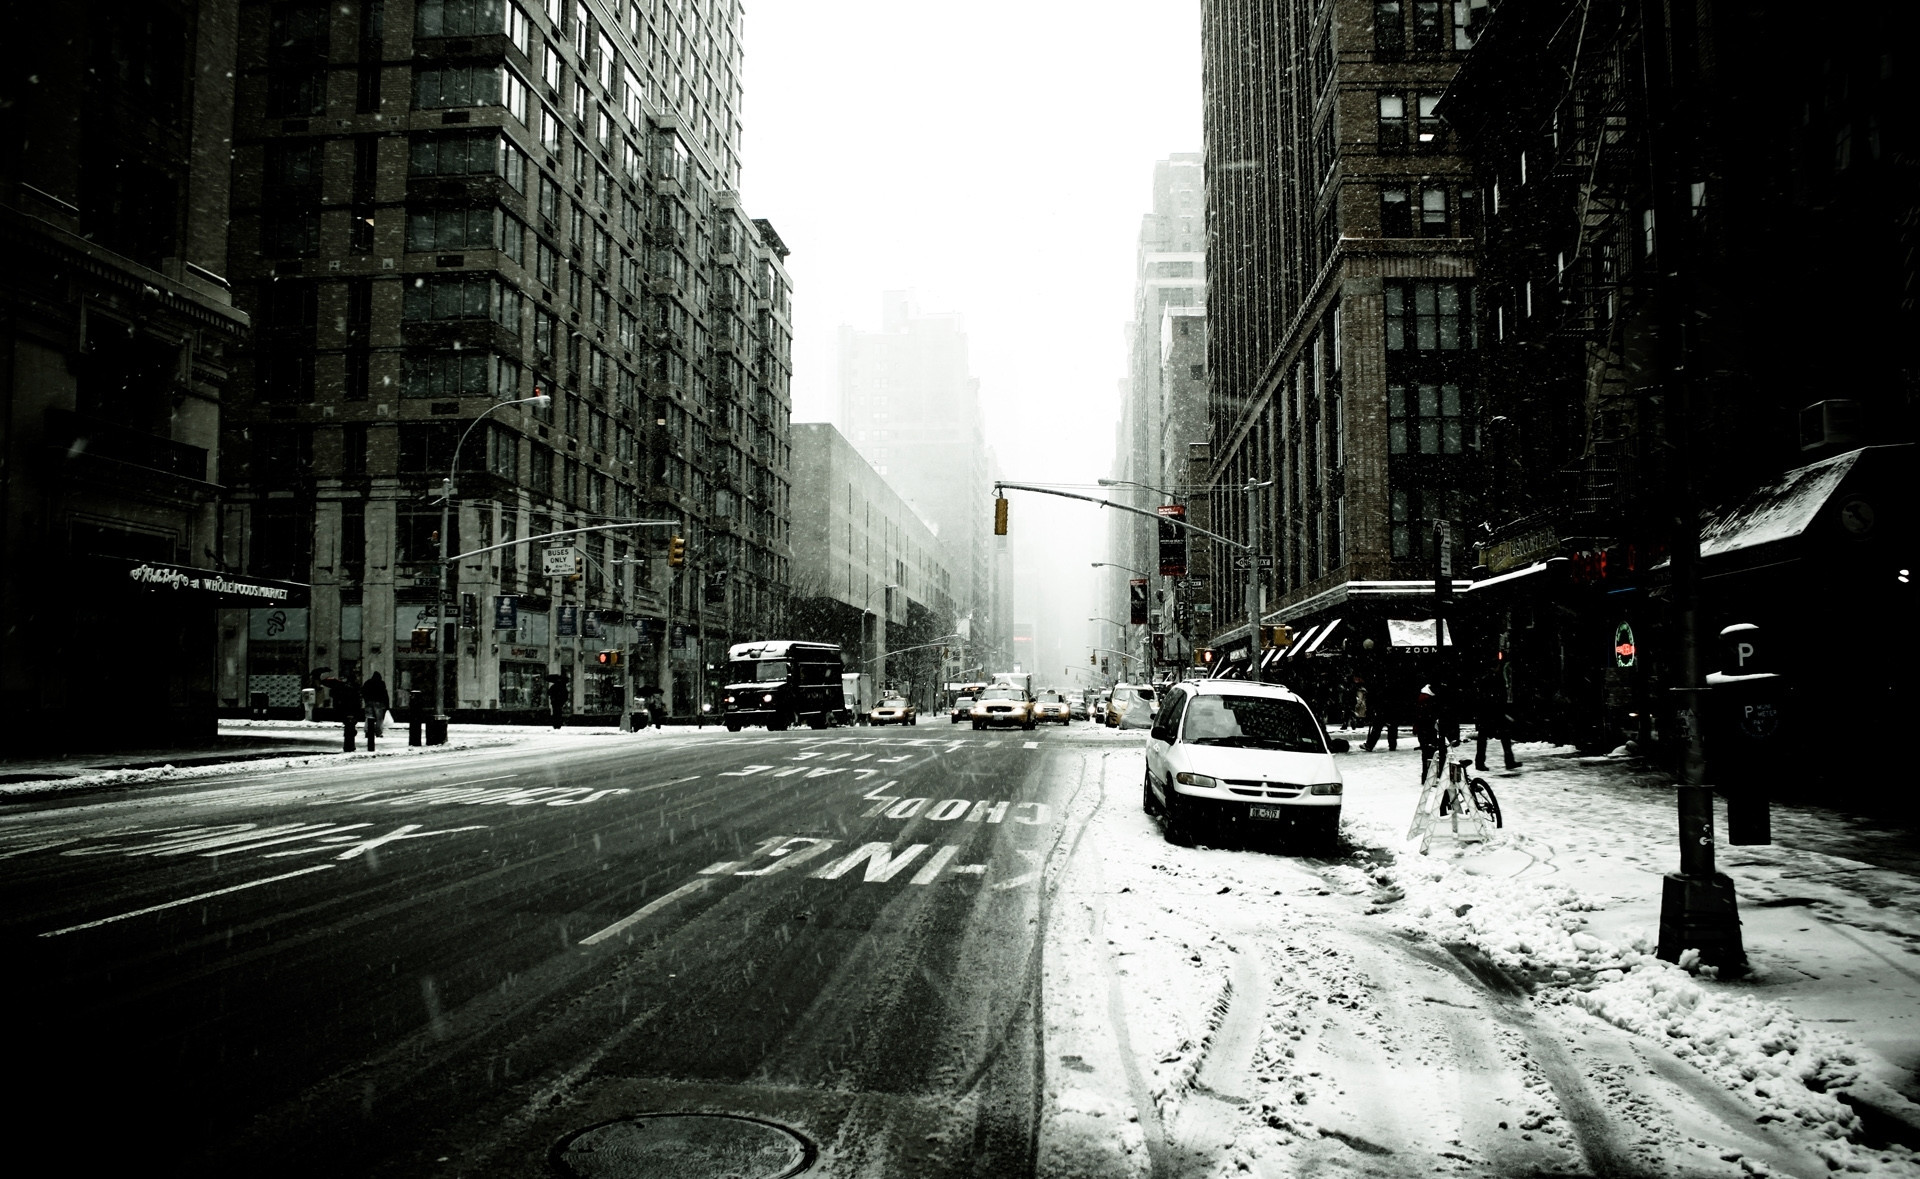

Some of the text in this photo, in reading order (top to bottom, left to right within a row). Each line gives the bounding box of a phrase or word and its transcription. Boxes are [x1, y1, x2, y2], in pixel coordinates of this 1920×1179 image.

[203, 576, 234, 594] WHOLE
[235, 583, 258, 597] FOODS
[260, 586, 289, 600] MARKET
[1738, 642, 1754, 667] P
[861, 797, 1056, 826] CHOOL
